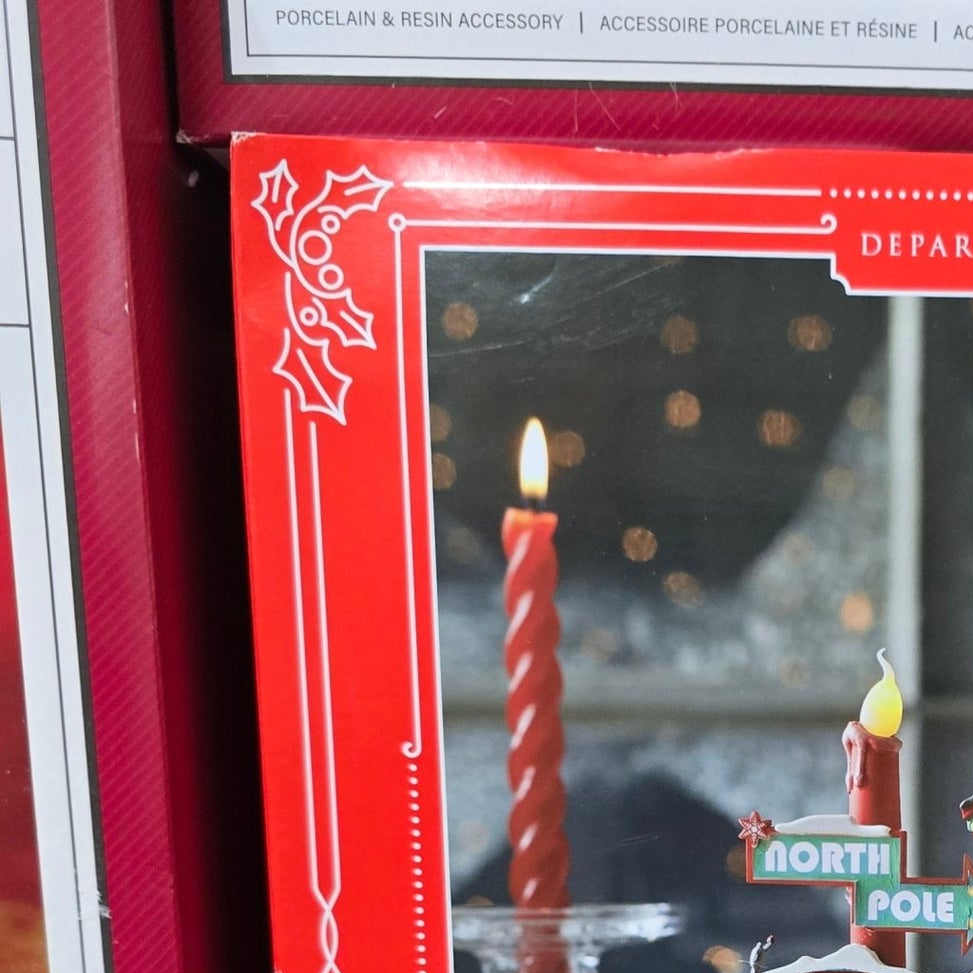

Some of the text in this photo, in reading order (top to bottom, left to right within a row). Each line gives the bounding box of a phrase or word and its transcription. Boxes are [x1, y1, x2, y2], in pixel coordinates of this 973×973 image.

[276, 10, 563, 29] PORCELAIN & RESIN ACCESSORY
[600, 16, 917, 38] ACCESSOIRE PORCELAINE ET RÉSINE
[765, 840, 890, 875] NORTH
[868, 890, 954, 923] POLE
